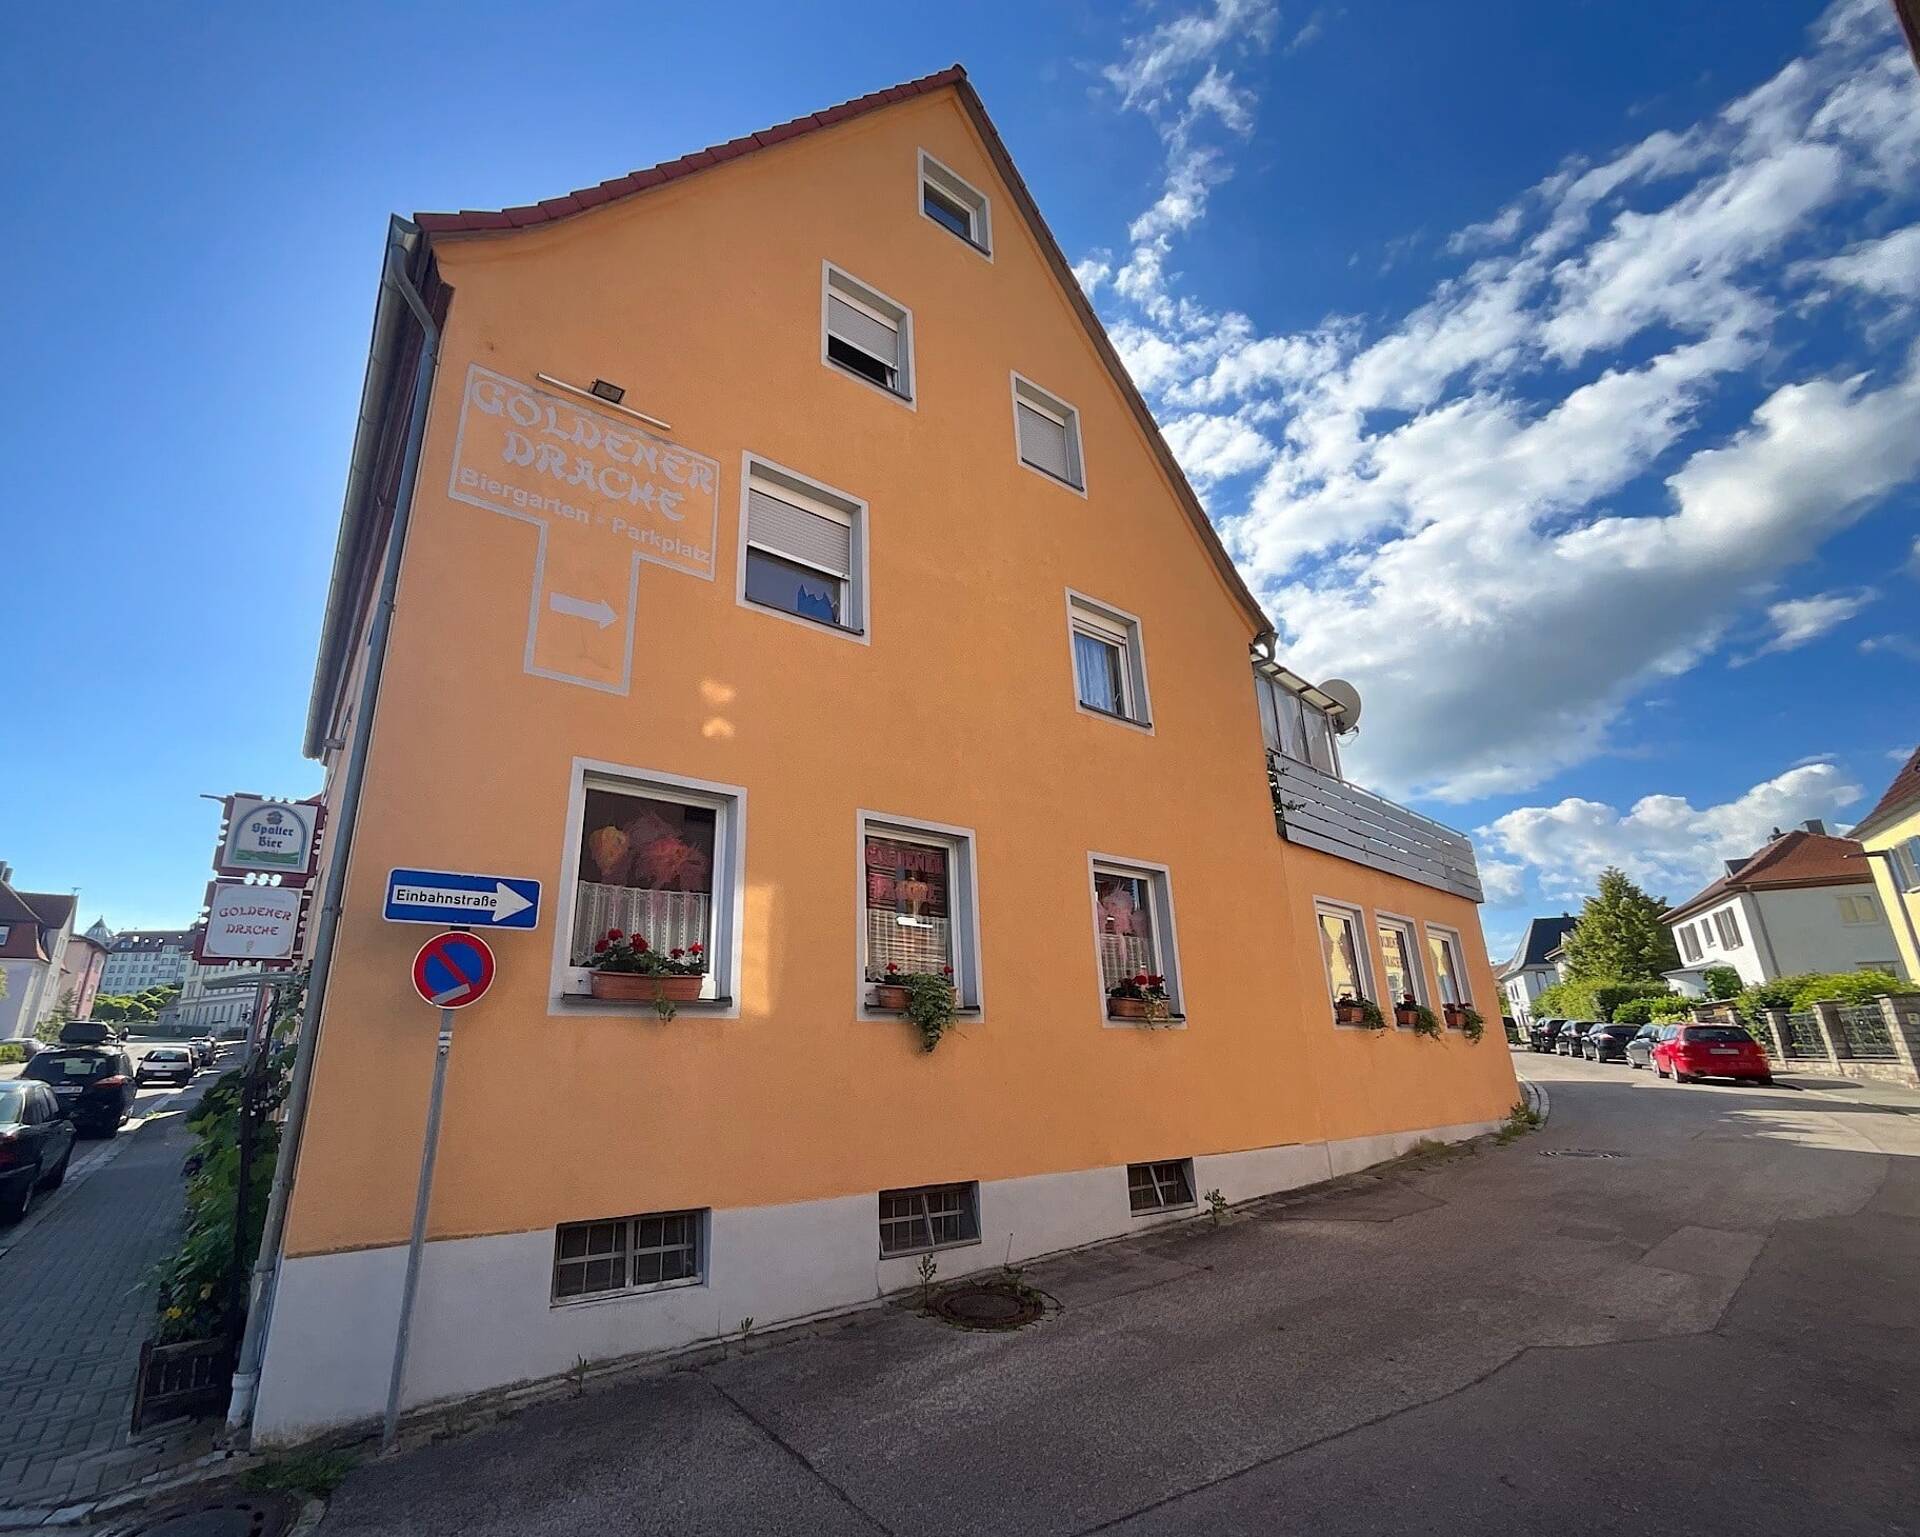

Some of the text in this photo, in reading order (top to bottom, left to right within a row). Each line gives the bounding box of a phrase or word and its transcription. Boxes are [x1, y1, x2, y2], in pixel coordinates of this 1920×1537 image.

[471, 380, 714, 495] GOLDENER
[503, 431, 687, 522] DRACHE
[459, 468, 590, 524] Biergarten
[612, 517, 712, 562] Parkplatz
[251, 822, 294, 836] Spalter
[258, 836, 283, 849] Bier
[396, 888, 498, 908] Einbahnstraße
[219, 906, 292, 921] GOLDENER
[226, 923, 280, 936] DRACHE
